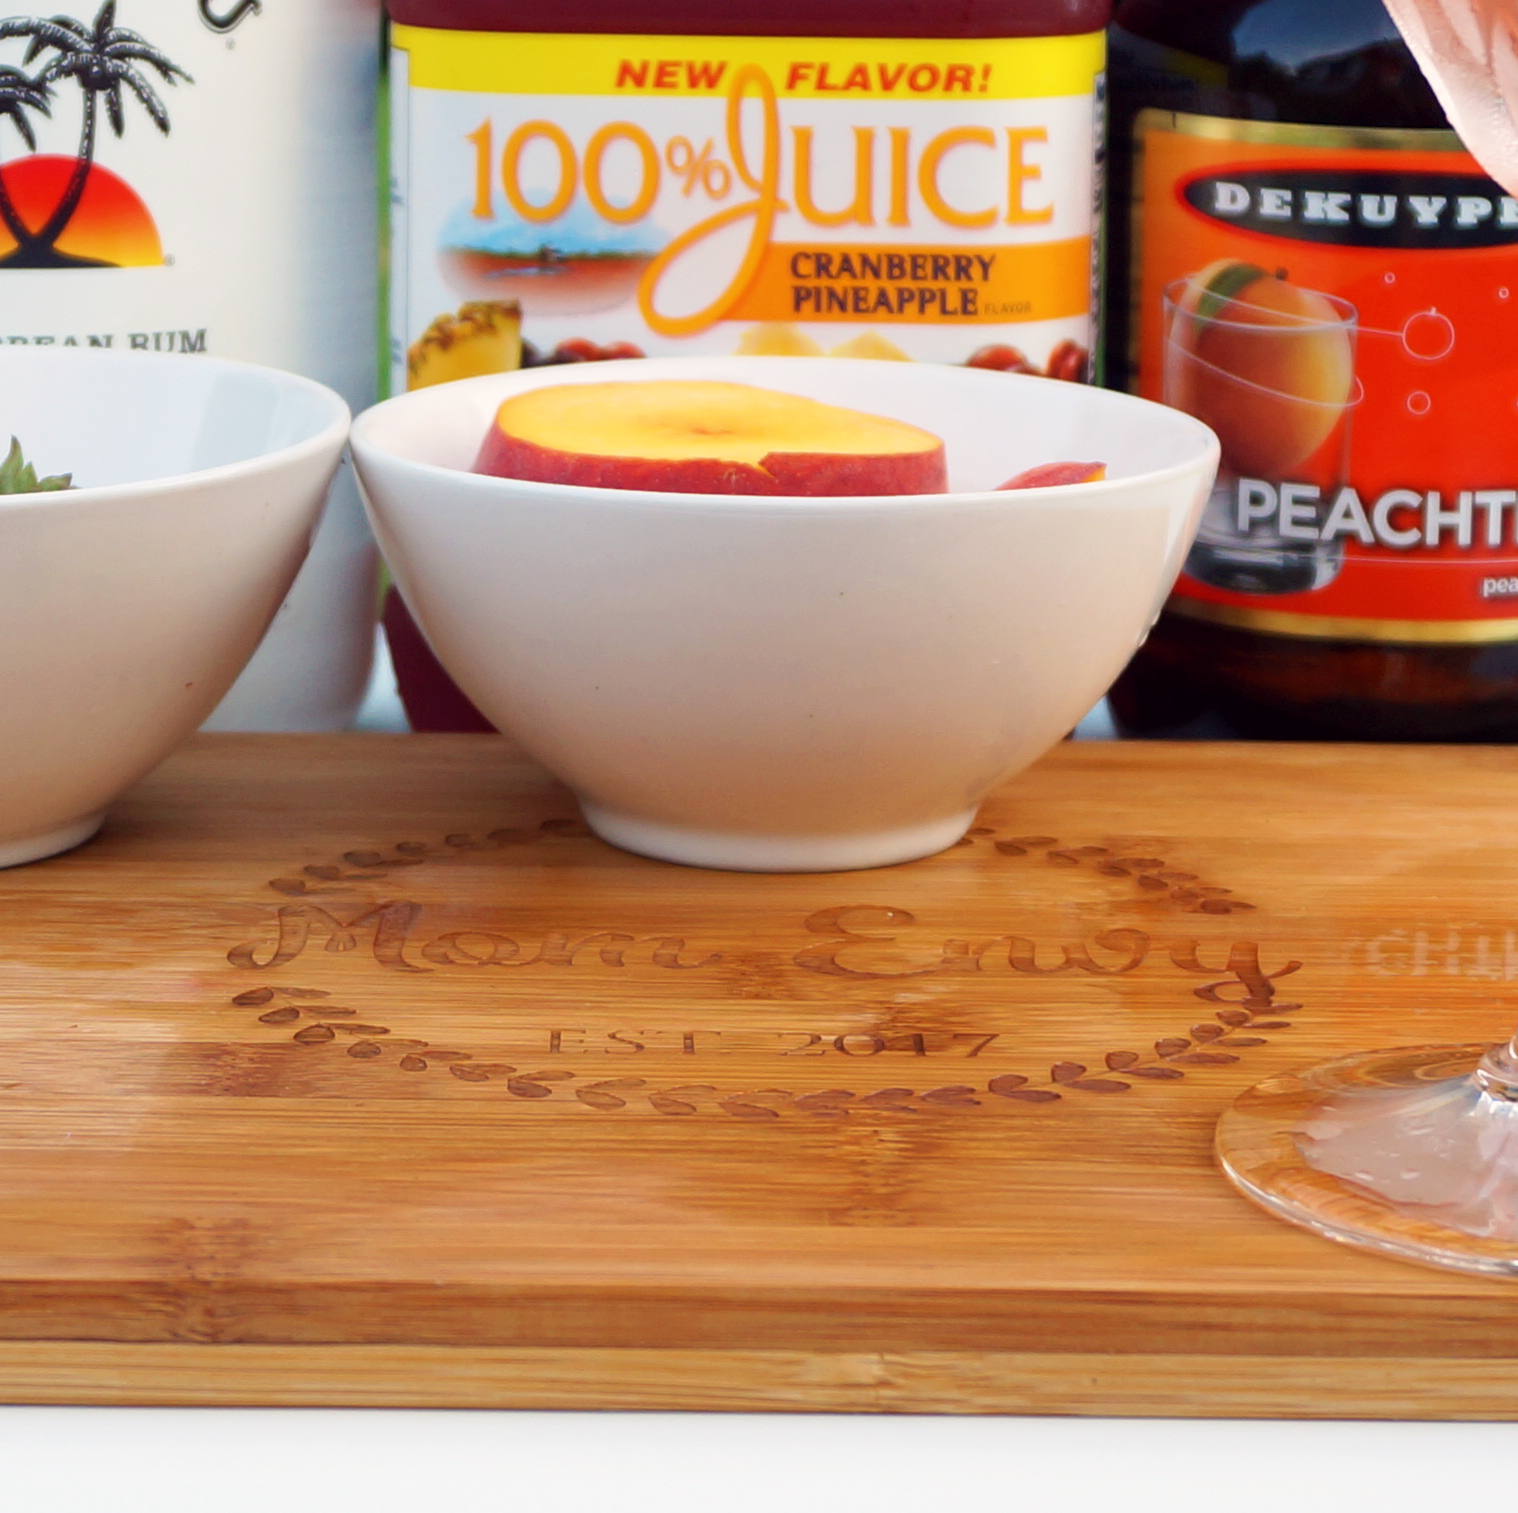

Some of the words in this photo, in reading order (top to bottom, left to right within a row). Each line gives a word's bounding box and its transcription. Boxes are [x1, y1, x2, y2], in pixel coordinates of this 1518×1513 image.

[614, 58, 729, 90] NEW
[784, 62, 993, 94] FLAVOR!
[464, 114, 732, 226] 100%
[638, 63, 1056, 338] JUICE
[790, 251, 997, 283] CRANBERRY
[791, 285, 980, 316] PINEAPPLE
[983, 300, 1032, 316] FLAVOR
[226, 900, 722, 973] Mom
[791, 904, 1303, 1005] Envy
[776, 1032, 1001, 1059] 2017
